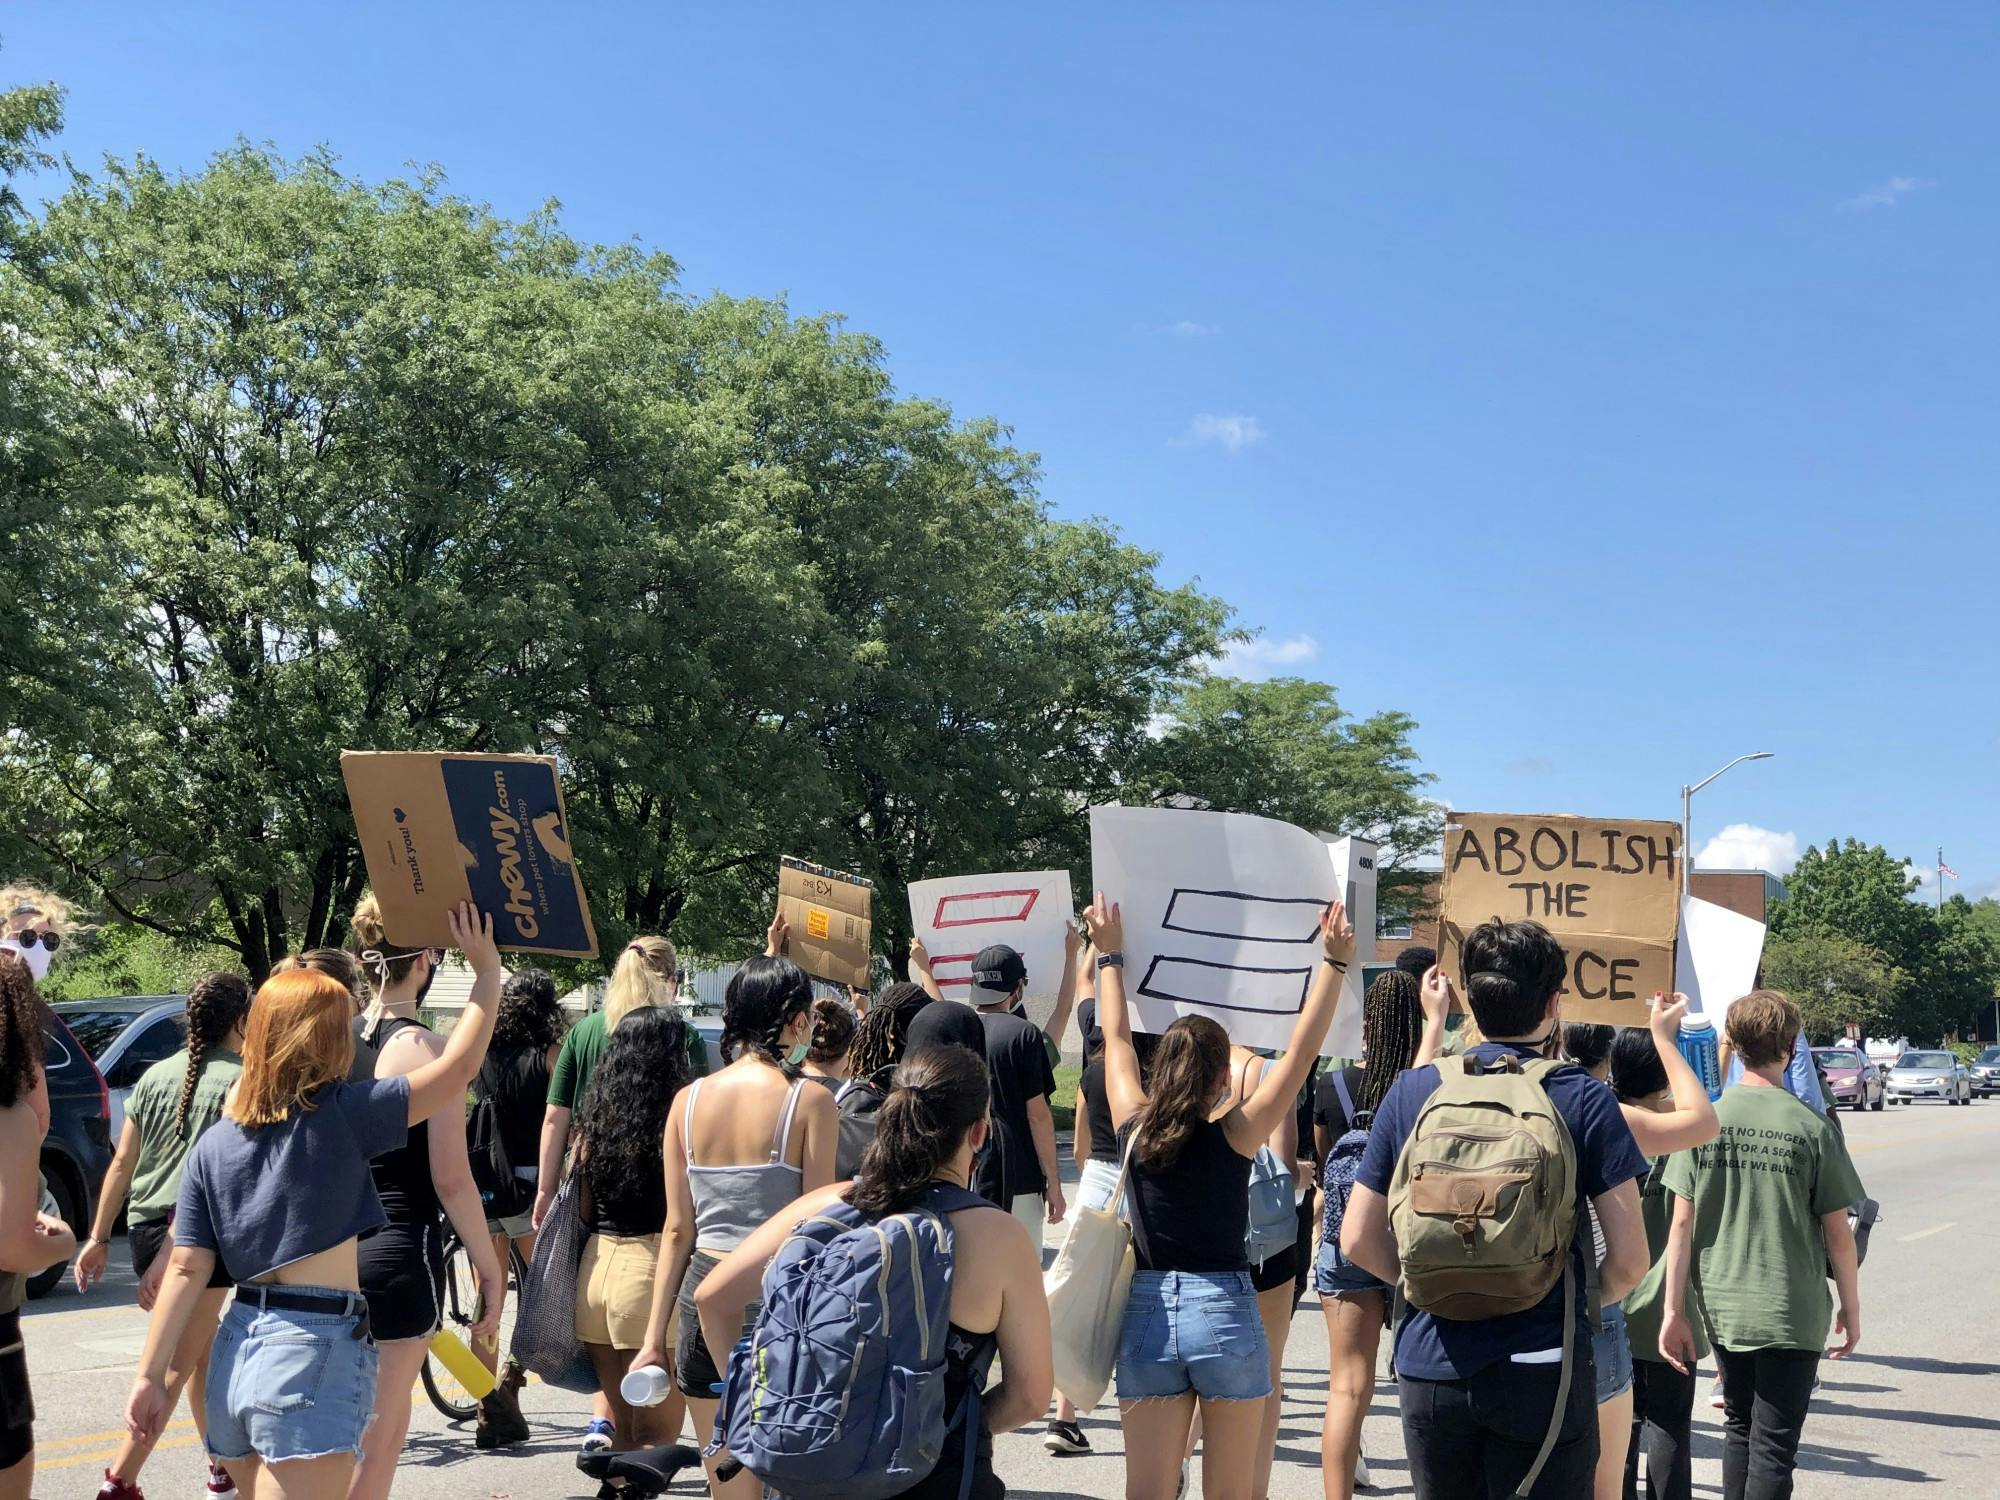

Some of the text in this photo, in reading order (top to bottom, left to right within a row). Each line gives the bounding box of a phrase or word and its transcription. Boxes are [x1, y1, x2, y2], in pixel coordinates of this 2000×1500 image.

[398, 827, 425, 895] Thank you!
[490, 770, 539, 939] chewy.com
[518, 799, 550, 916] where pet lovers shop
[1452, 826, 1675, 881] ABOLISH
[816, 880, 832, 896] K3
[1508, 881, 1591, 918] THE
[1720, 1126, 1807, 1147] RE NO LONGER
[1734, 1143, 1758, 1153] FOR
[1760, 1145, 1769, 1155] A
[1699, 1159, 1713, 1170] HE
[1715, 1159, 1747, 1170] TABLE
[1750, 1160, 1768, 1172] WE
